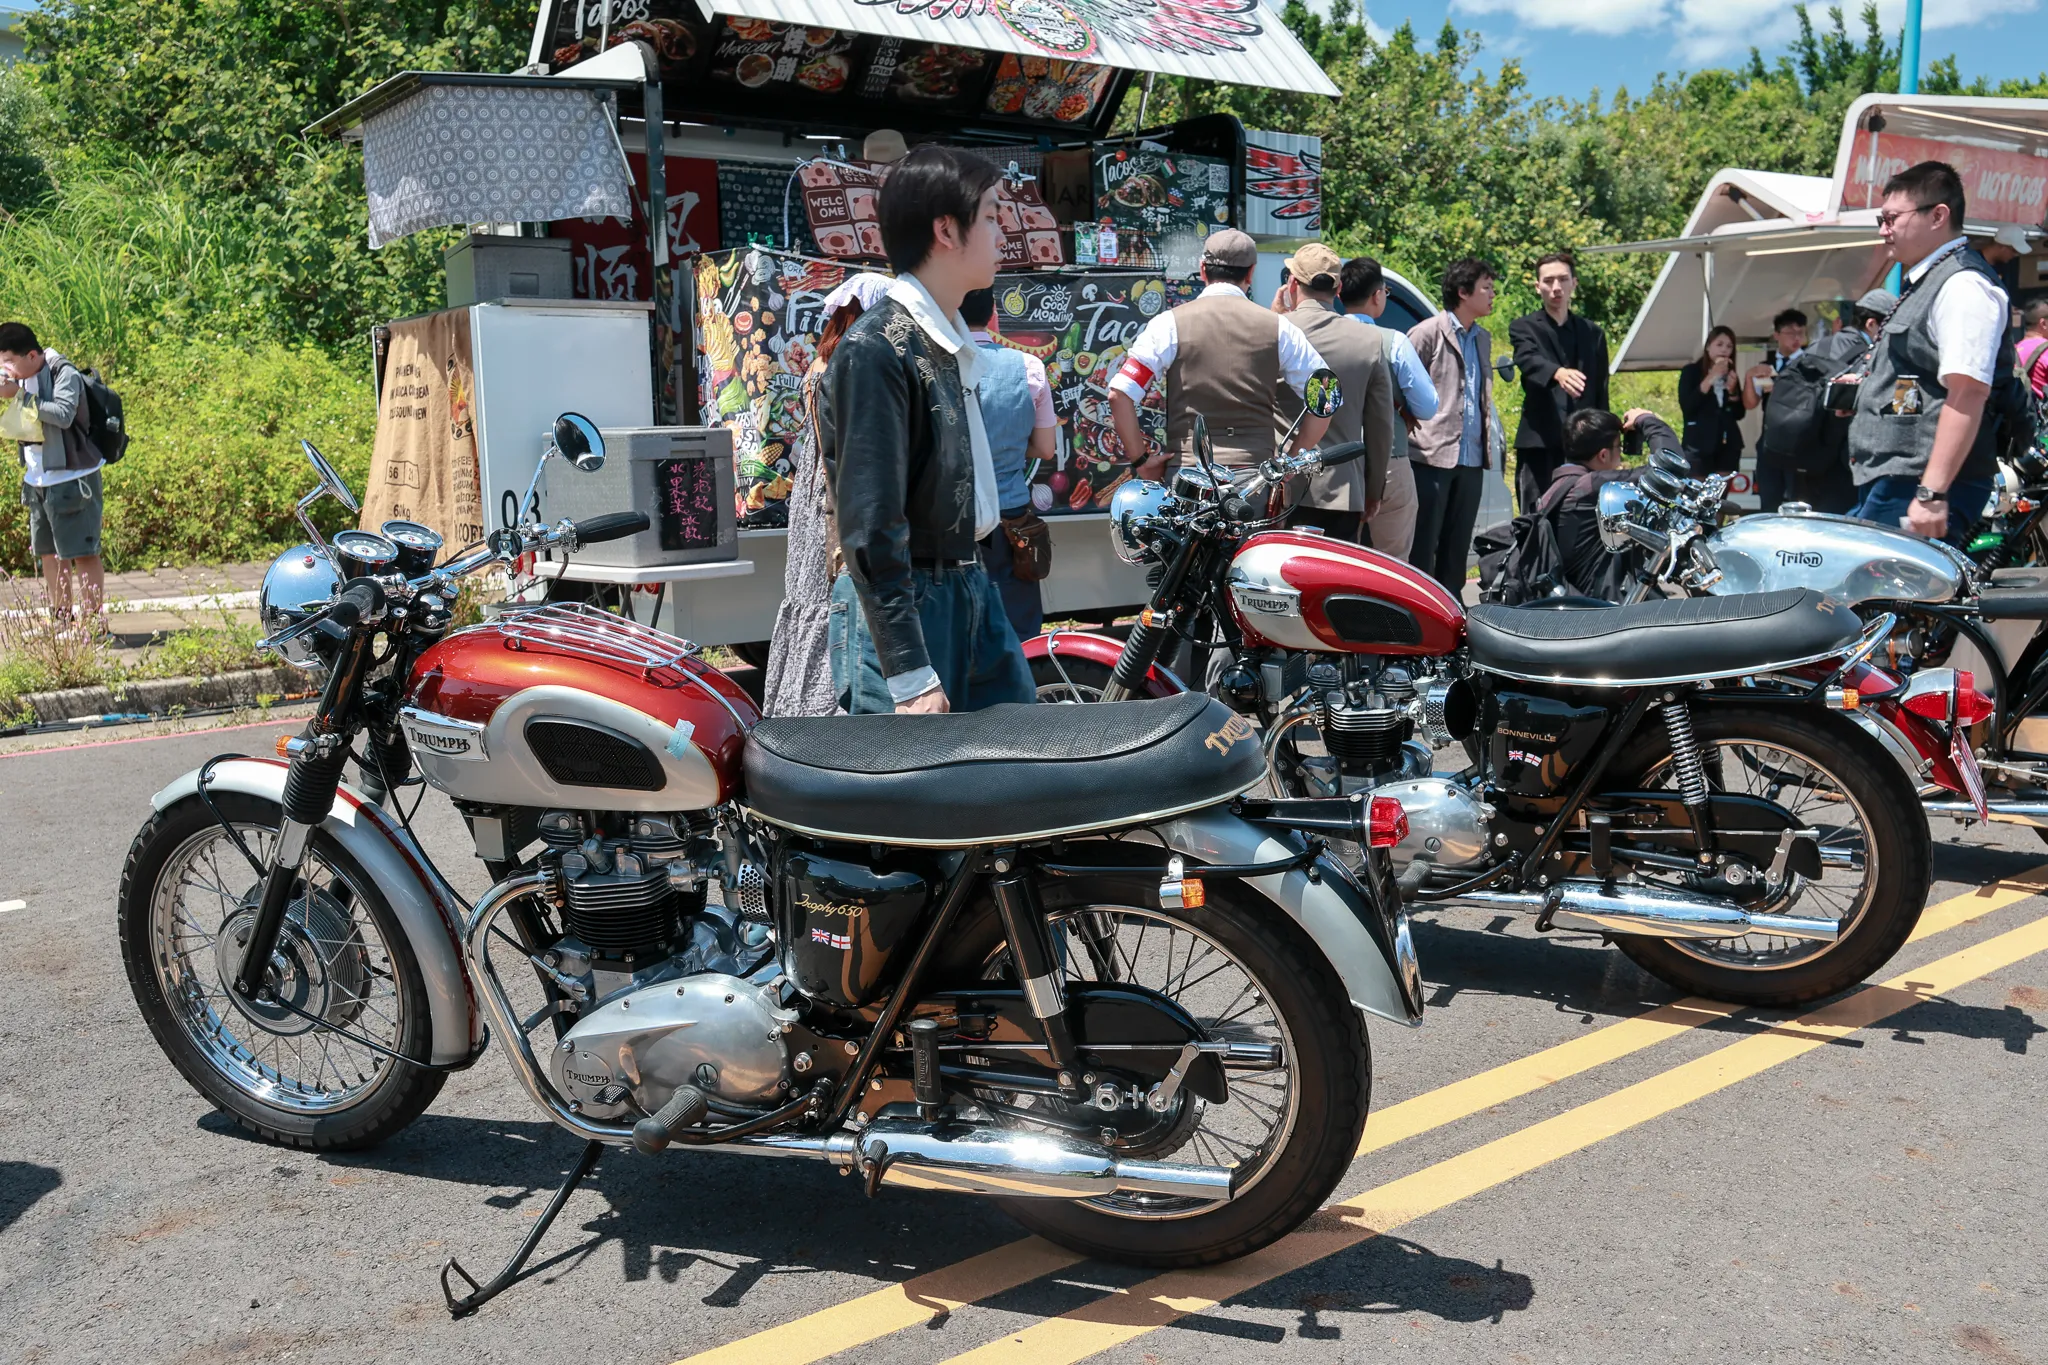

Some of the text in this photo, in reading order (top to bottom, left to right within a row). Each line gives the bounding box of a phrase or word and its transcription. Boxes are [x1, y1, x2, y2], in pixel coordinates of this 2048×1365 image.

[715, 40, 782, 57] Mexican
[873, 56, 897, 67] FOOD
[873, 67, 891, 75] Pita
[844, 175, 867, 183] DAY
[1095, 152, 1138, 191] Tacos
[1978, 171, 2009, 200] HOT
[2010, 175, 2047, 206] DOGS
[810, 196, 844, 208] WELC
[820, 207, 846, 218] OME
[1001, 241, 1023, 251] OME
[783, 262, 803, 276] PORK
[1040, 294, 1072, 313] Good
[785, 290, 831, 335] Pit
[1776, 550, 1823, 568] Triton
[1240, 594, 1290, 613] TRIUMPH
[408, 726, 471, 755] TRIUMPH
[1497, 727, 1556, 742] BONNEVILLE
[795, 893, 863, 917] Trophy 650
[566, 1068, 611, 1087] TRIUMPH
